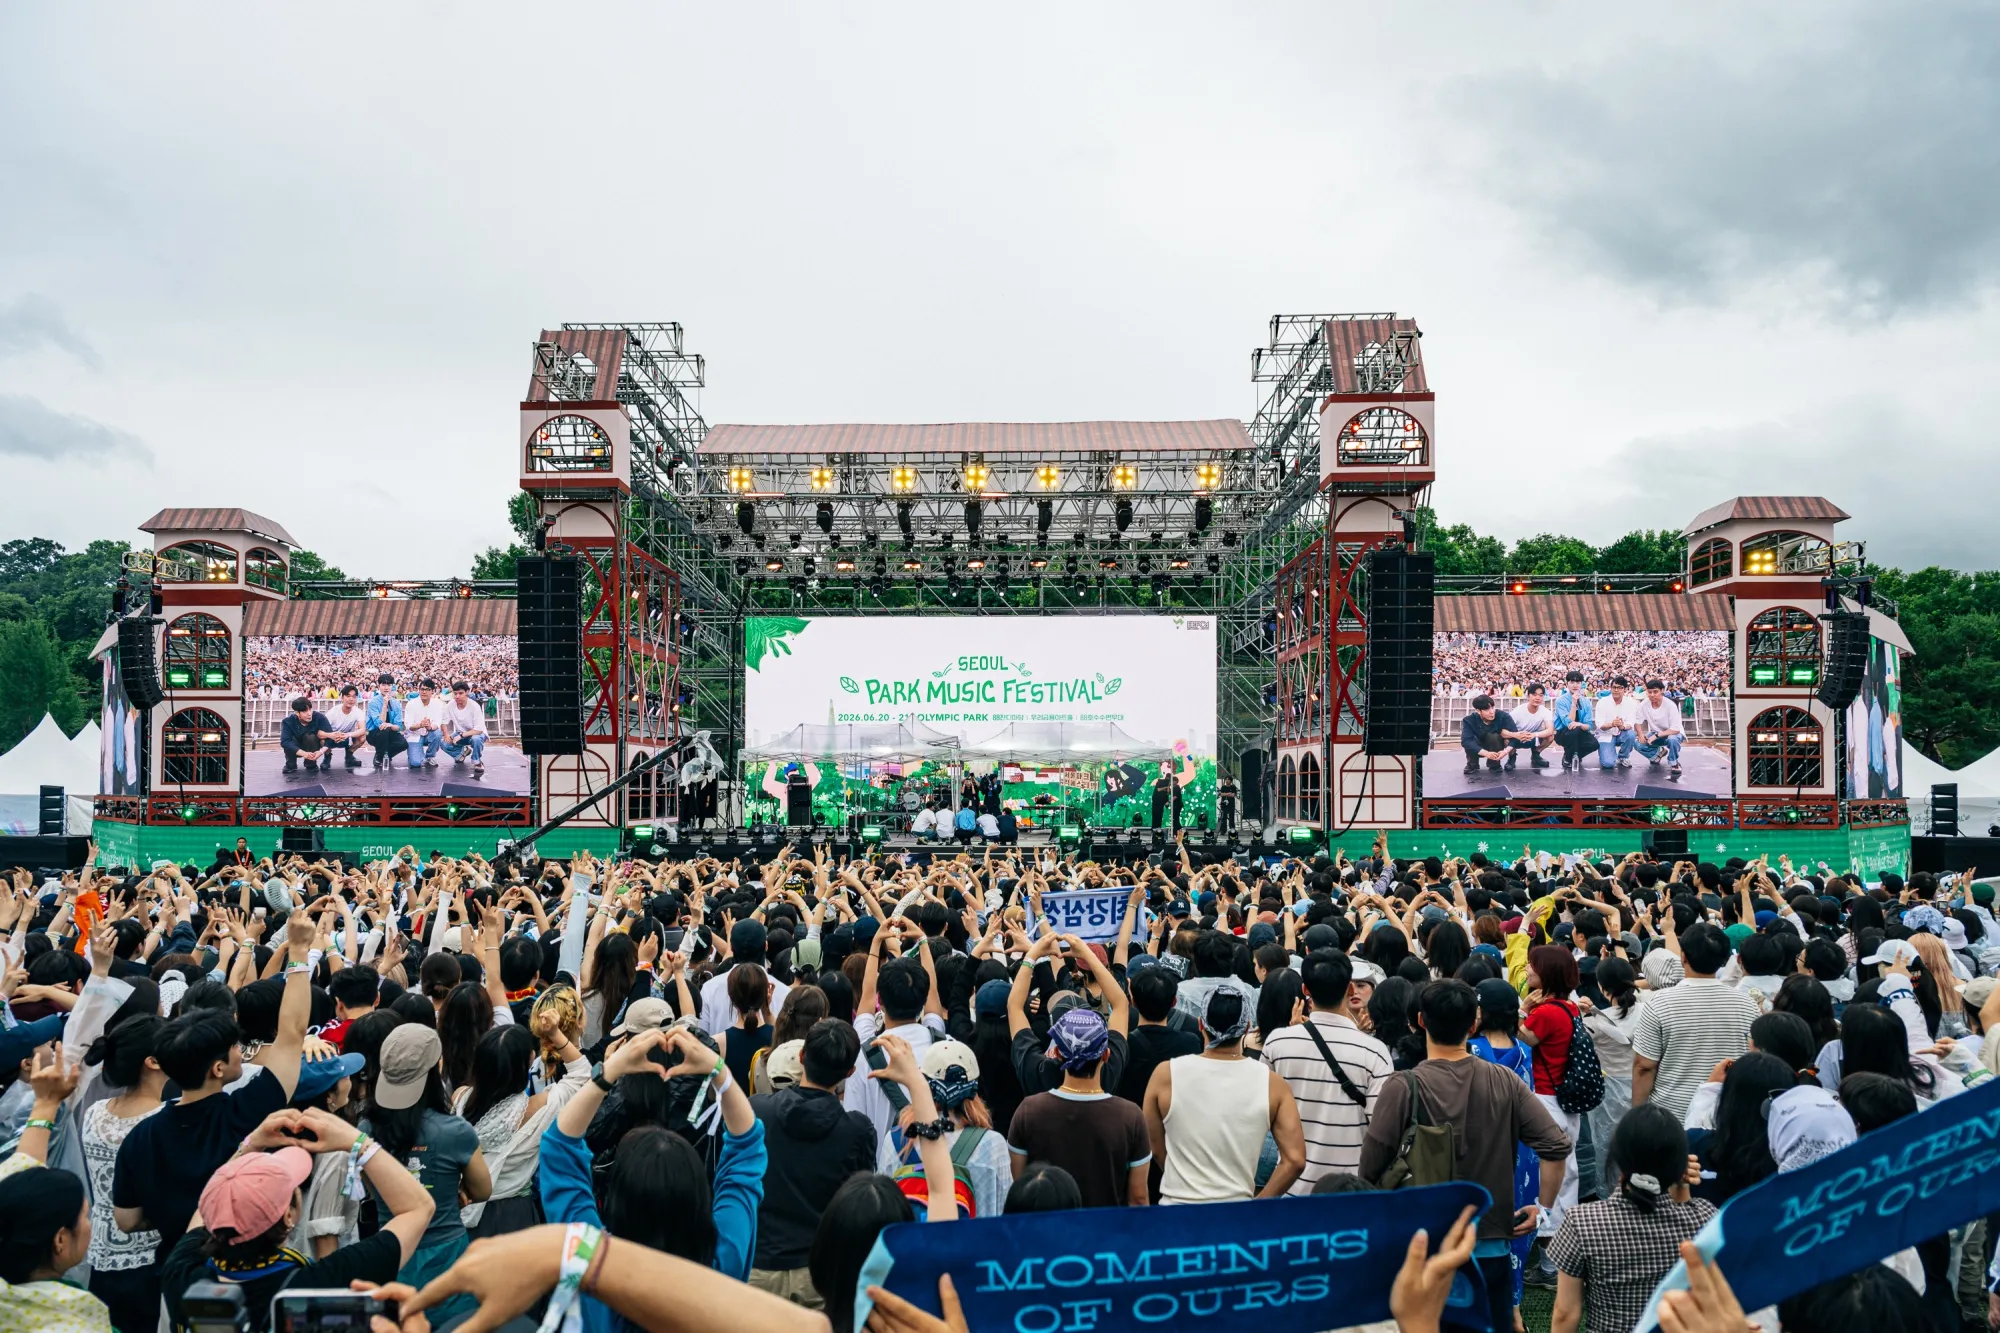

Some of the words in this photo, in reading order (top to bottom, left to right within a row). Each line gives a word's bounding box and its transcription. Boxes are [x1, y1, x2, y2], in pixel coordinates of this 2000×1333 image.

[958, 655, 1008, 671] SEOUL
[865, 678, 921, 705] PARK
[926, 680, 996, 705] MUSIC
[1003, 678, 1103, 704] FESTIVAL
[837, 713, 890, 722] 2026.06.20
[917, 713, 960, 722] OLYMPIC
[963, 713, 989, 722] PARK
[362, 846, 396, 857] SEOUL
[1876, 1149, 2000, 1217] OUR
[1784, 1199, 1866, 1257] OF
[975, 1228, 1369, 1292] MOMENTS
[1013, 1298, 1112, 1333] OF
[1132, 1274, 1331, 1323] OURS
